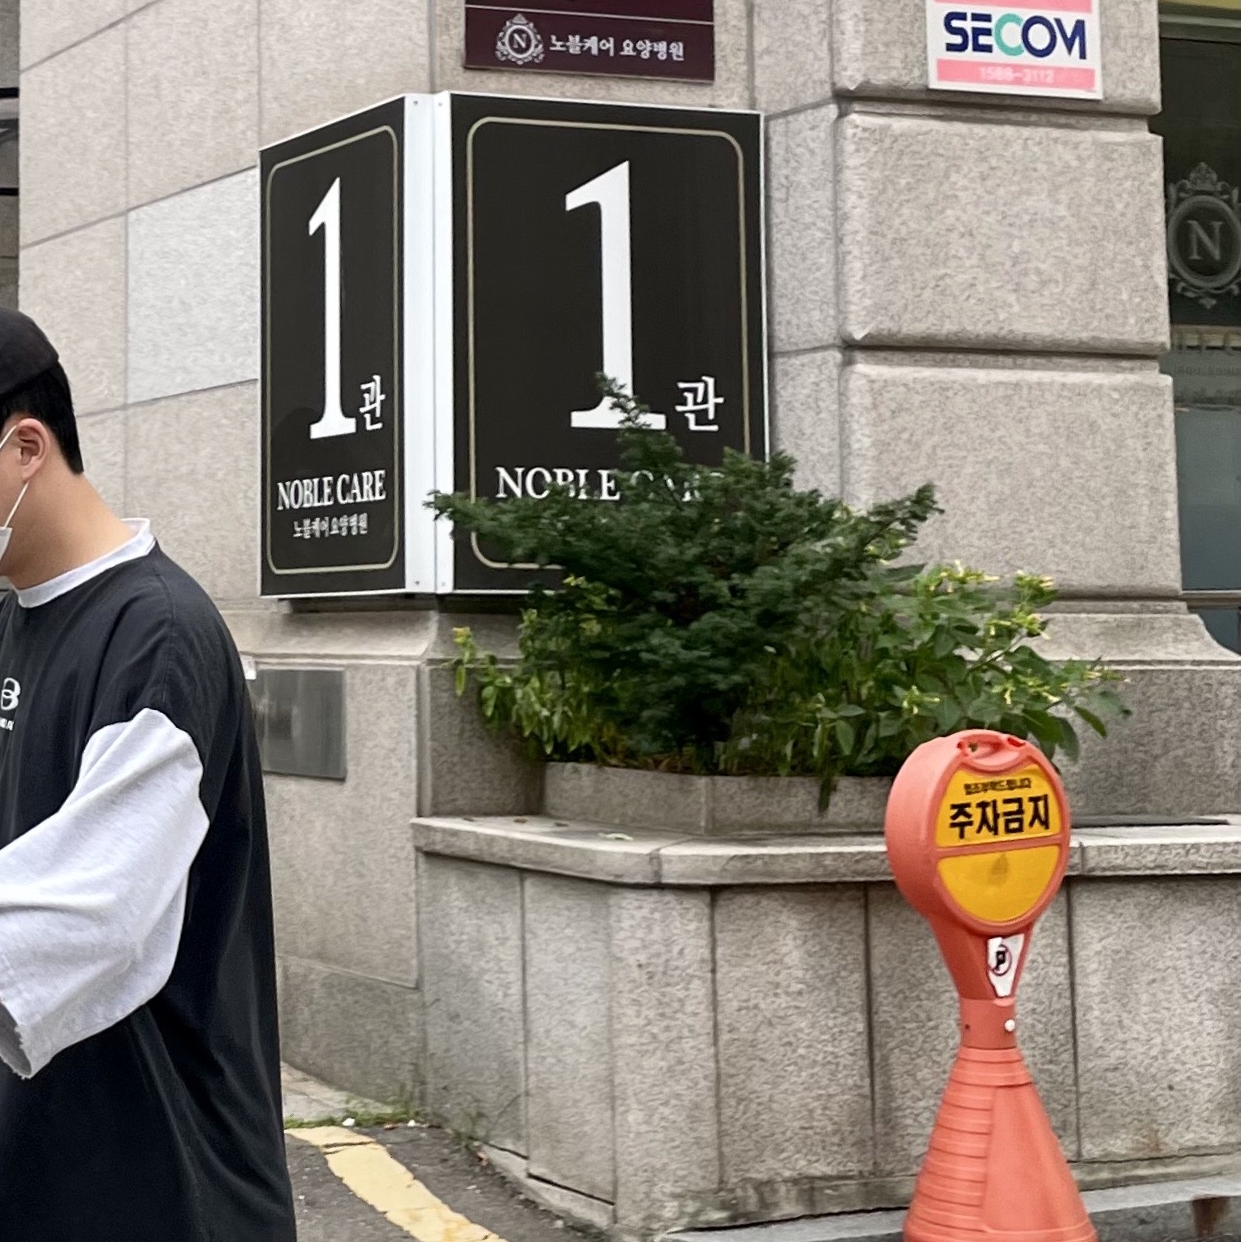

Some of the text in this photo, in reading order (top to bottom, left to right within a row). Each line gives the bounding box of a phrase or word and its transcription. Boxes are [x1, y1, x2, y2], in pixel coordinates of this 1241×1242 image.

[549, 34, 685, 62] 노블케어 요양병원
[943, 11, 1088, 60] SECOM
[276, 469, 387, 511] NOBLE CARE
[949, 793, 1050, 840] 주차금지
